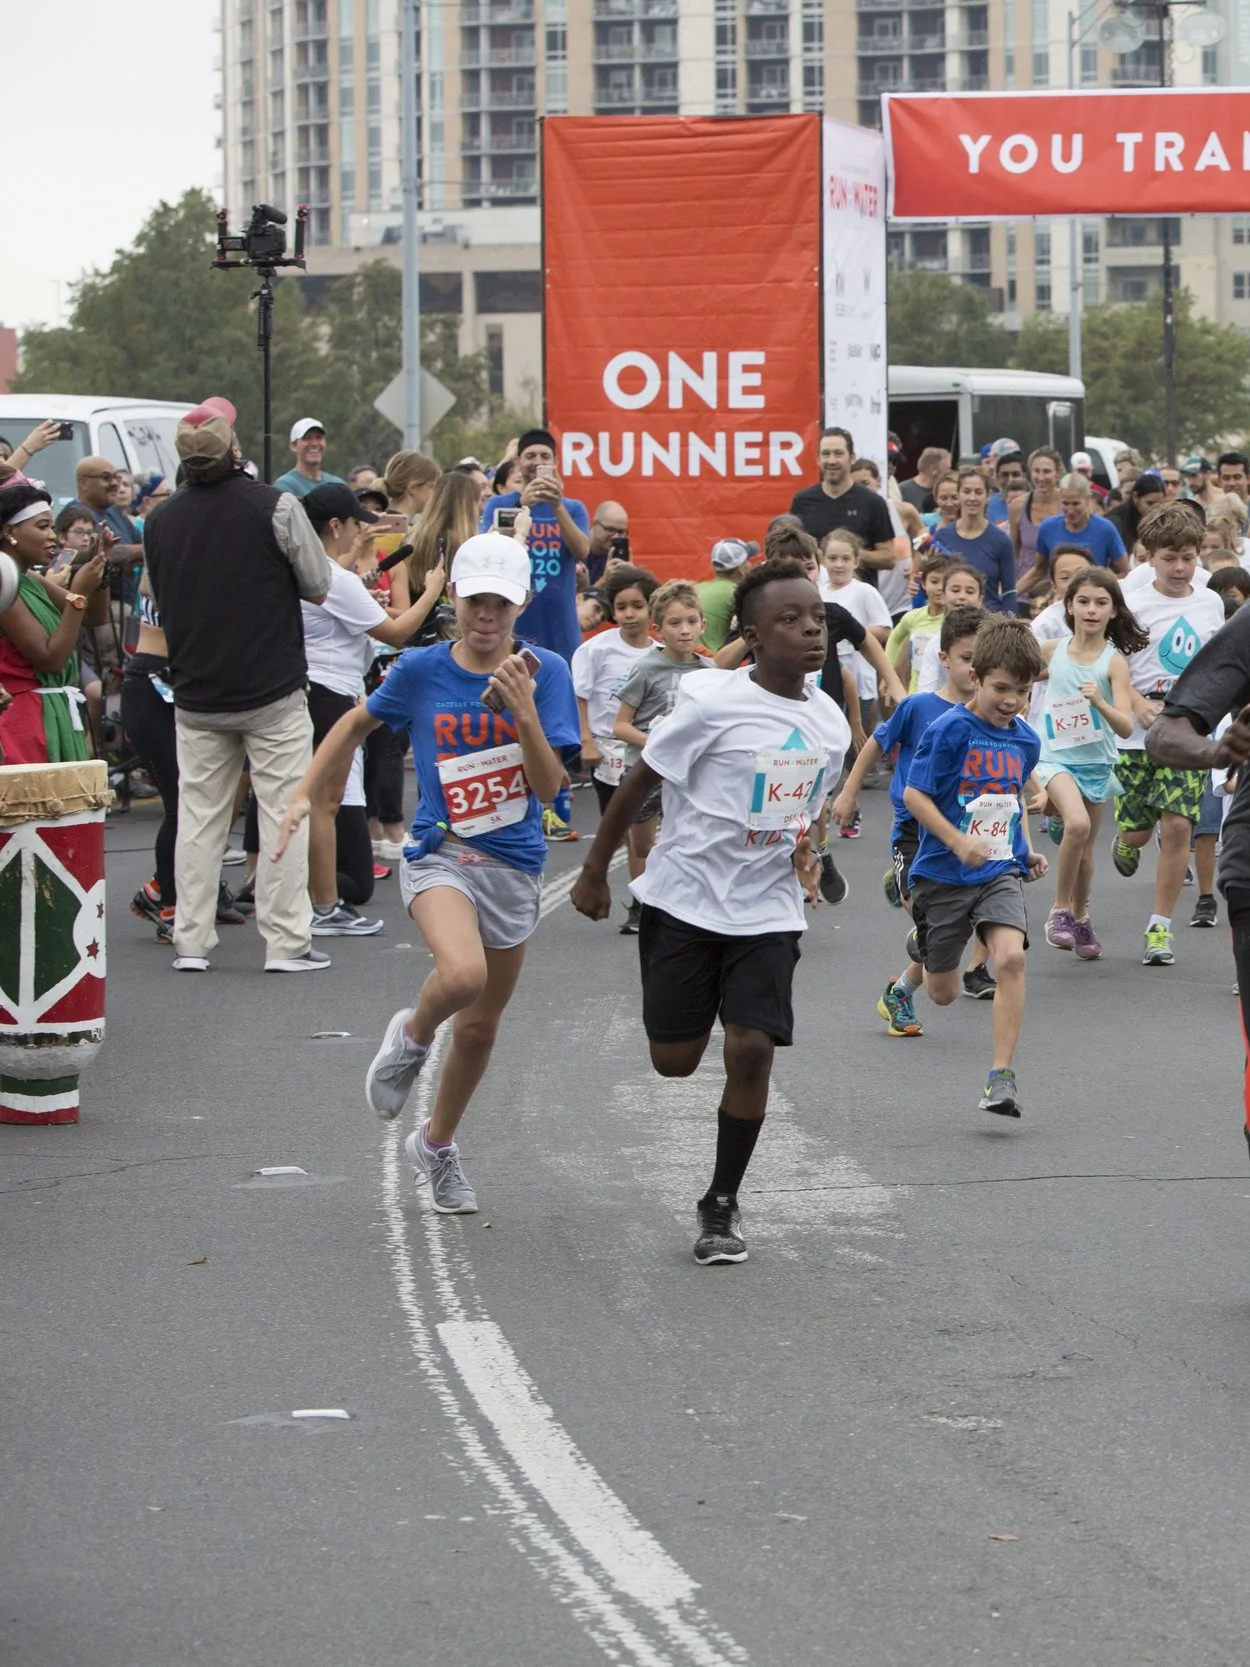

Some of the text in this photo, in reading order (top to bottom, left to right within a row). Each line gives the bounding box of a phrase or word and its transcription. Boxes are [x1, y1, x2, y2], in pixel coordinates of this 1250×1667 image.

[958, 132, 1084, 175] YOU
[602, 350, 766, 411] ONE
[561, 431, 805, 477] RUNNER
[531, 523, 561, 538] UN
[528, 541, 561, 557] OR
[434, 713, 520, 746] RUN
[1055, 713, 1090, 731] K-75
[795, 758, 818, 766] WATER
[963, 748, 1023, 782] RUN
[448, 770, 528, 814] 3254
[767, 781, 814, 802] K-42
[970, 820, 1009, 837] K-84
